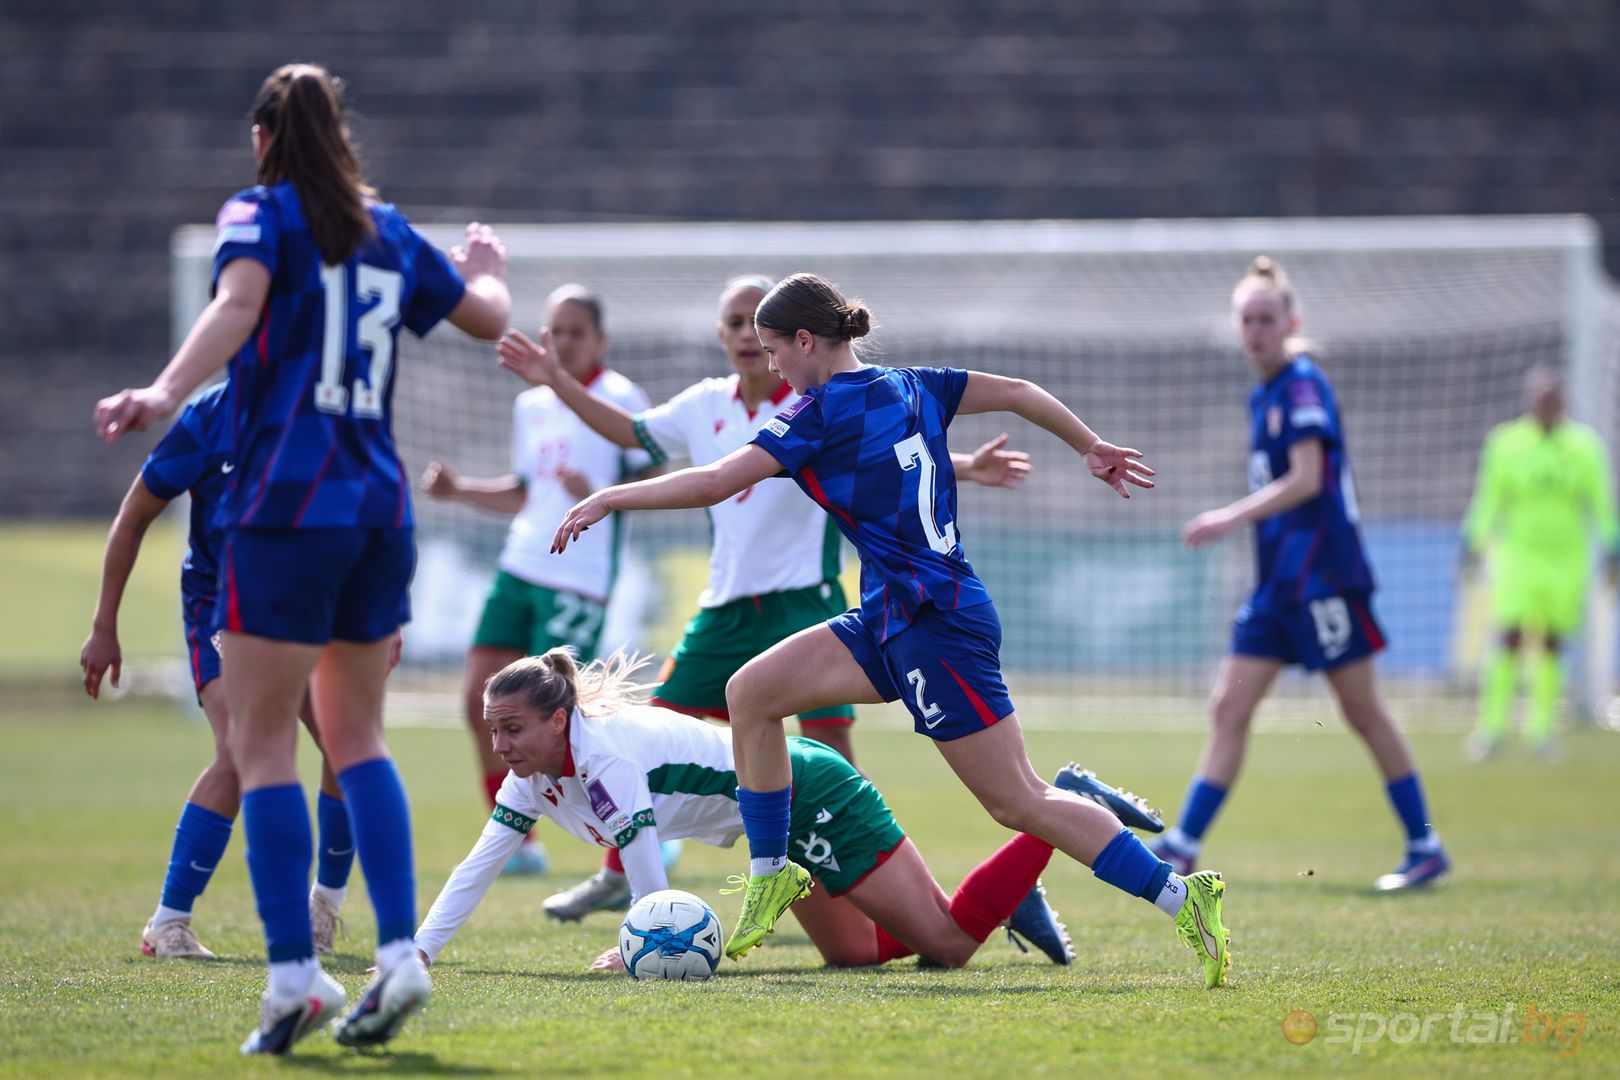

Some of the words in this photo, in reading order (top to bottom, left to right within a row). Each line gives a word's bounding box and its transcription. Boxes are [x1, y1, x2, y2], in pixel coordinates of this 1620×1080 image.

[314, 263, 405, 420] 13
[893, 431, 957, 556] 2
[906, 667, 942, 720] 2
